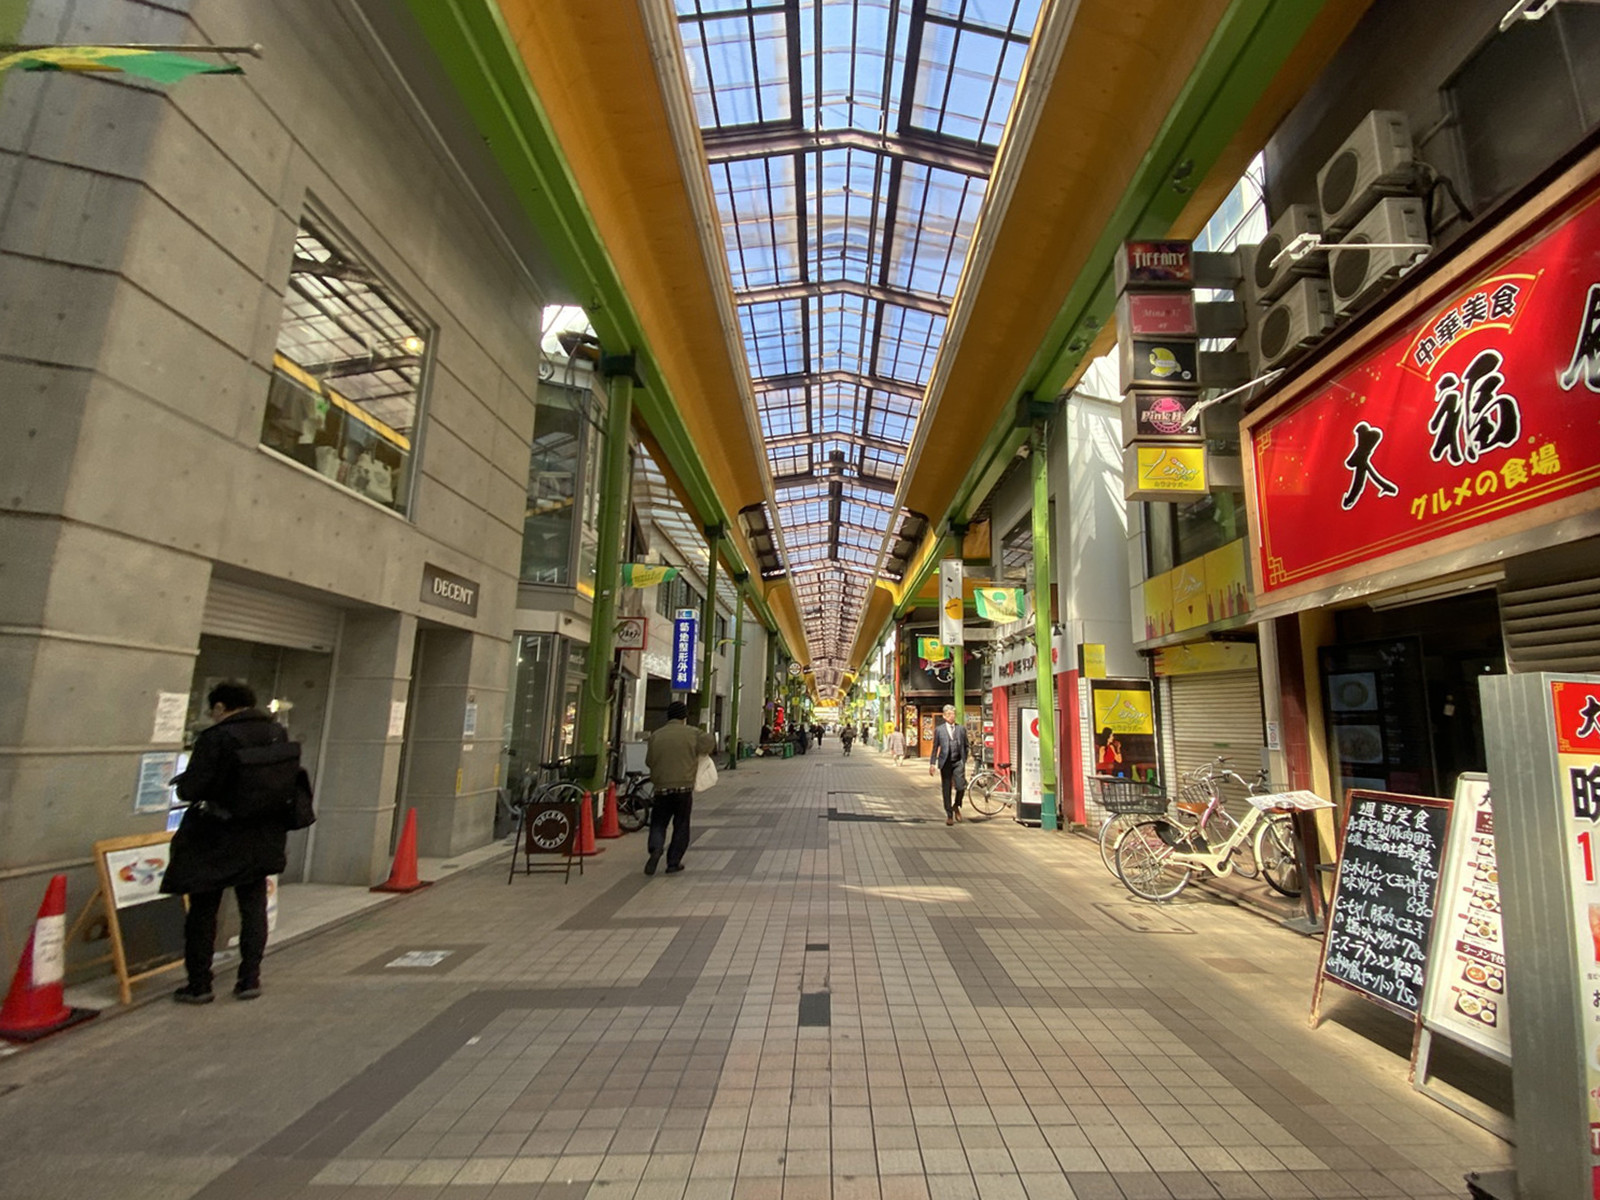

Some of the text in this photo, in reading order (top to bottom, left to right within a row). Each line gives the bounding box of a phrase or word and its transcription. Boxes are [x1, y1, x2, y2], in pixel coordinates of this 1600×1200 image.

[1133, 252, 1186, 269] TIFFANY
[1414, 283, 1520, 366] 中華美食
[1140, 410, 1169, 423] Pink
[1411, 443, 1562, 520] グルメの食場
[433, 577, 474, 605] DECENT
